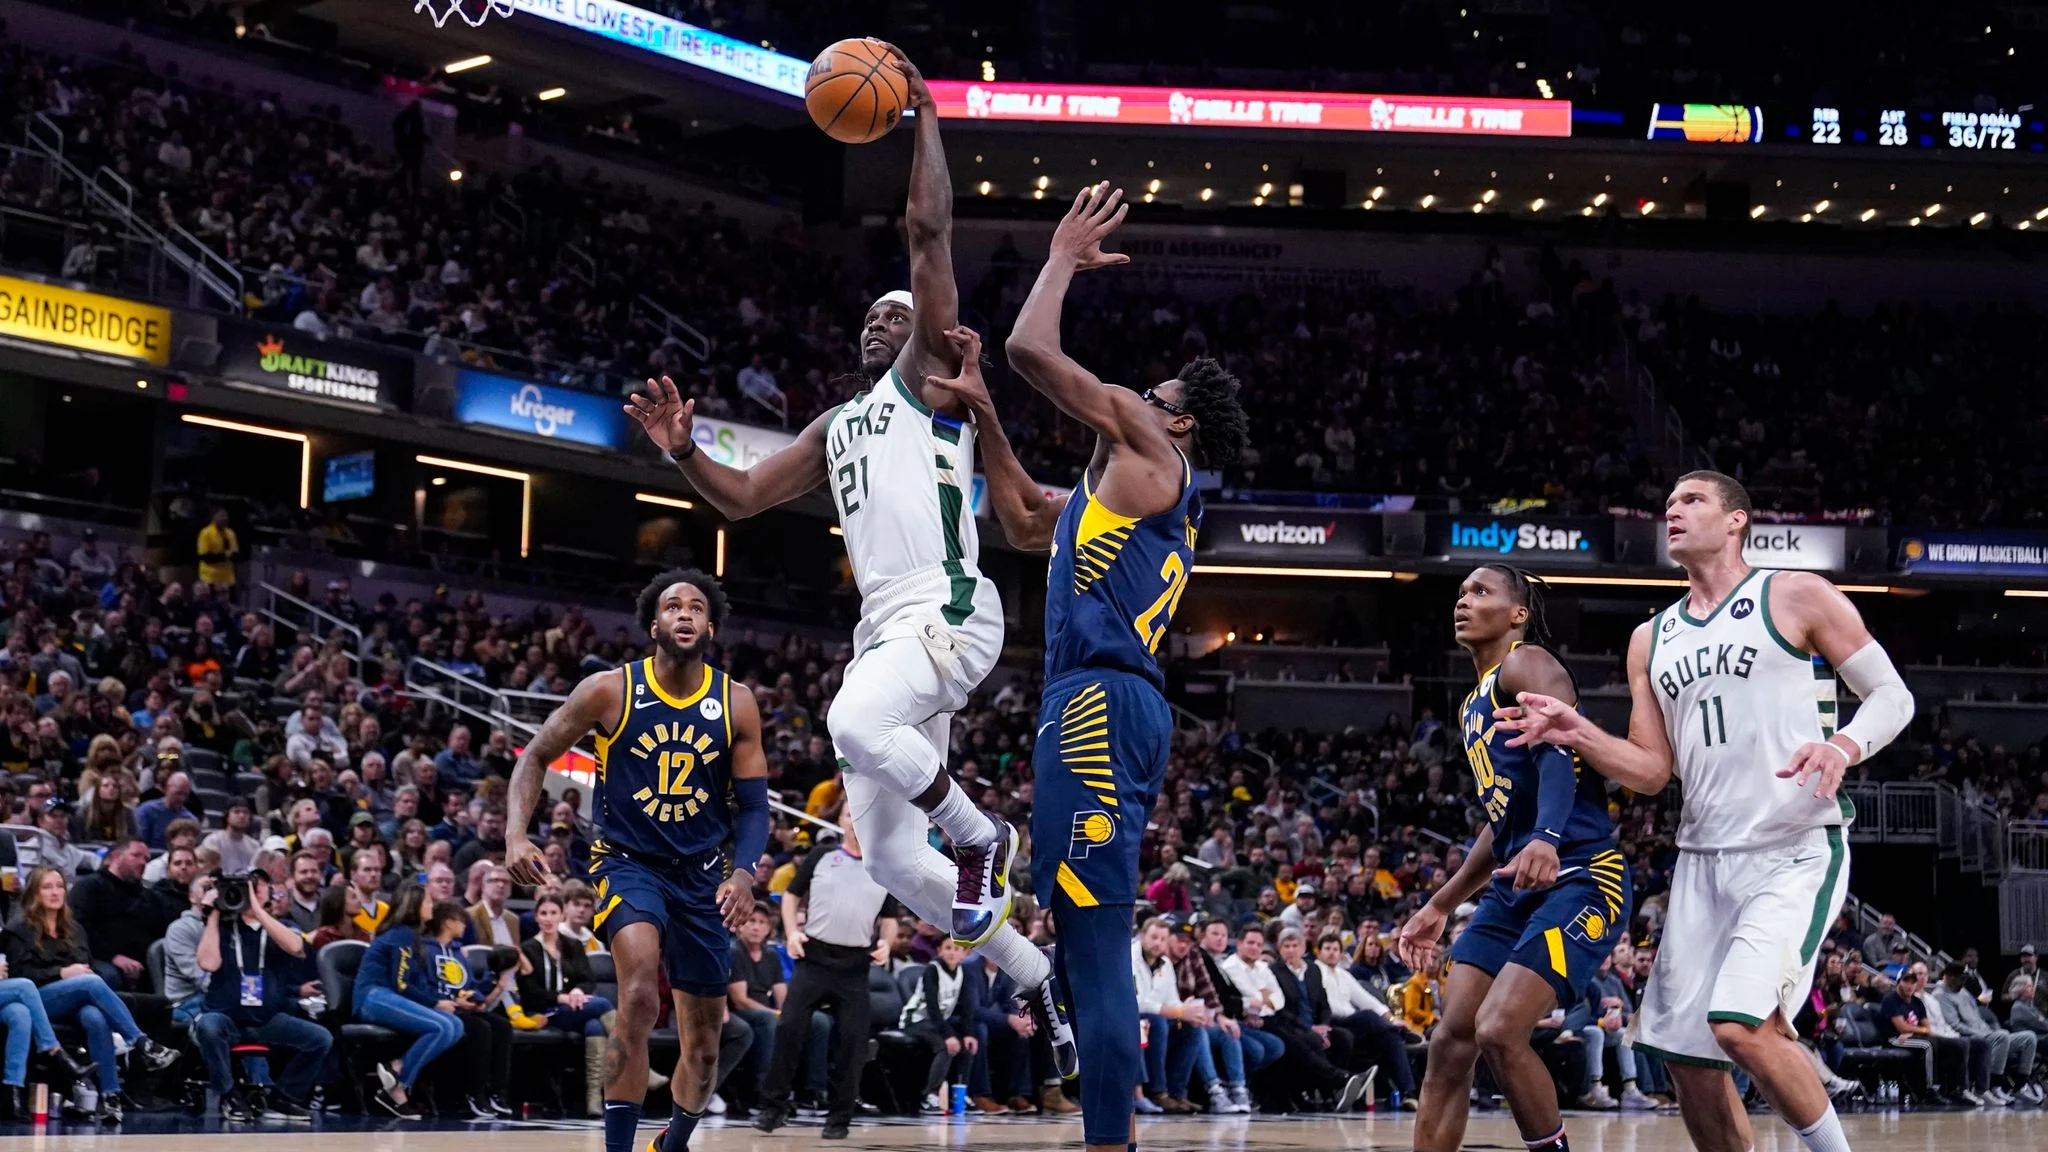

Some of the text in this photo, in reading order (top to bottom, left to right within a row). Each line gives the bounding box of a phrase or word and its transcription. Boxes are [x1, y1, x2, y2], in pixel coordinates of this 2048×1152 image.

[575, 0, 655, 42] LOWEST
[663, 25, 704, 56] TIRE
[778, 62, 807, 88] PE
[1812, 122, 1841, 144] 22
[1879, 124, 1908, 146] 28
[1880, 110, 1906, 124] AST
[1942, 112, 2021, 128] FIELD GOALS
[1949, 126, 2016, 149] 36/72
[0, 290, 158, 352] GAINBRIDGE
[260, 351, 379, 388] DRAFTKINGS
[288, 374, 377, 404] SPORTSBOOK
[511, 384, 575, 436] Kroger
[839, 455, 868, 516] 21
[1240, 521, 1326, 546] verizon
[1928, 543, 1945, 561] WE
[1946, 544, 1978, 562] GROW
[1979, 545, 2041, 564] BASKETBALL
[635, 683, 645, 695] 6
[1658, 643, 1758, 701] BUCKS
[1698, 695, 1727, 747] 11
[630, 721, 720, 765] INDIANA
[657, 751, 695, 796] 12
[632, 786, 710, 822] PACERS
[1485, 774, 1512, 823] CERS
